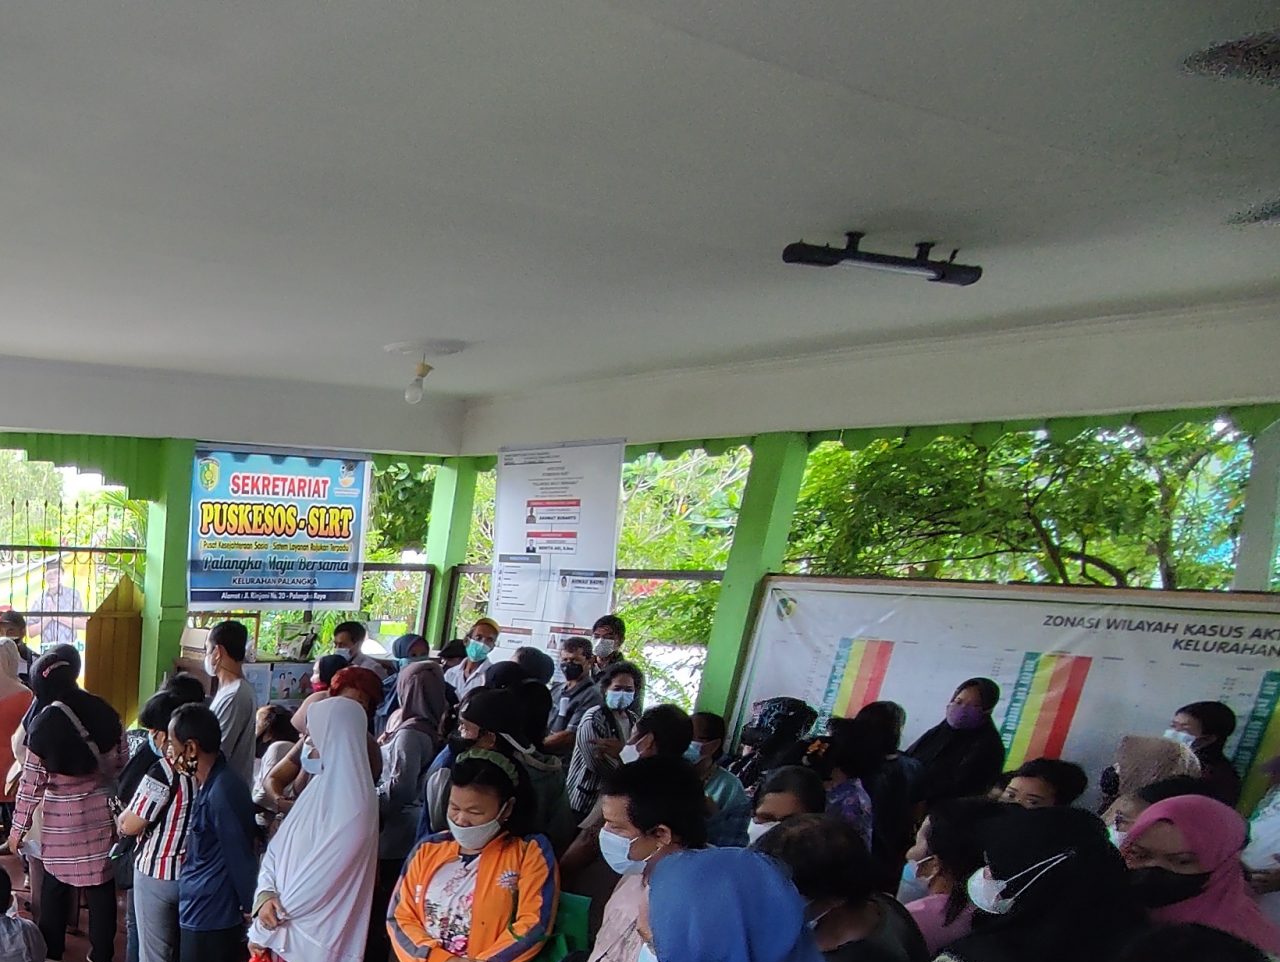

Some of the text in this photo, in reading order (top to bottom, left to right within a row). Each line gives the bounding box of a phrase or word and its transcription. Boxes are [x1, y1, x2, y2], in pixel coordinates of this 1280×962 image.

[231, 474, 329, 498] SEKRETARIAT
[201, 501, 297, 536] PUSKESOS
[307, 505, 354, 538] SLRT
[203, 554, 262, 574] Palangka
[298, 557, 349, 571] Bersama
[232, 577, 318, 586] KELURAHAN PALANGKA
[1042, 614, 1102, 629] ZONASI
[1106, 618, 1179, 634] WILAYAH
[1183, 623, 1245, 639] KASUS
